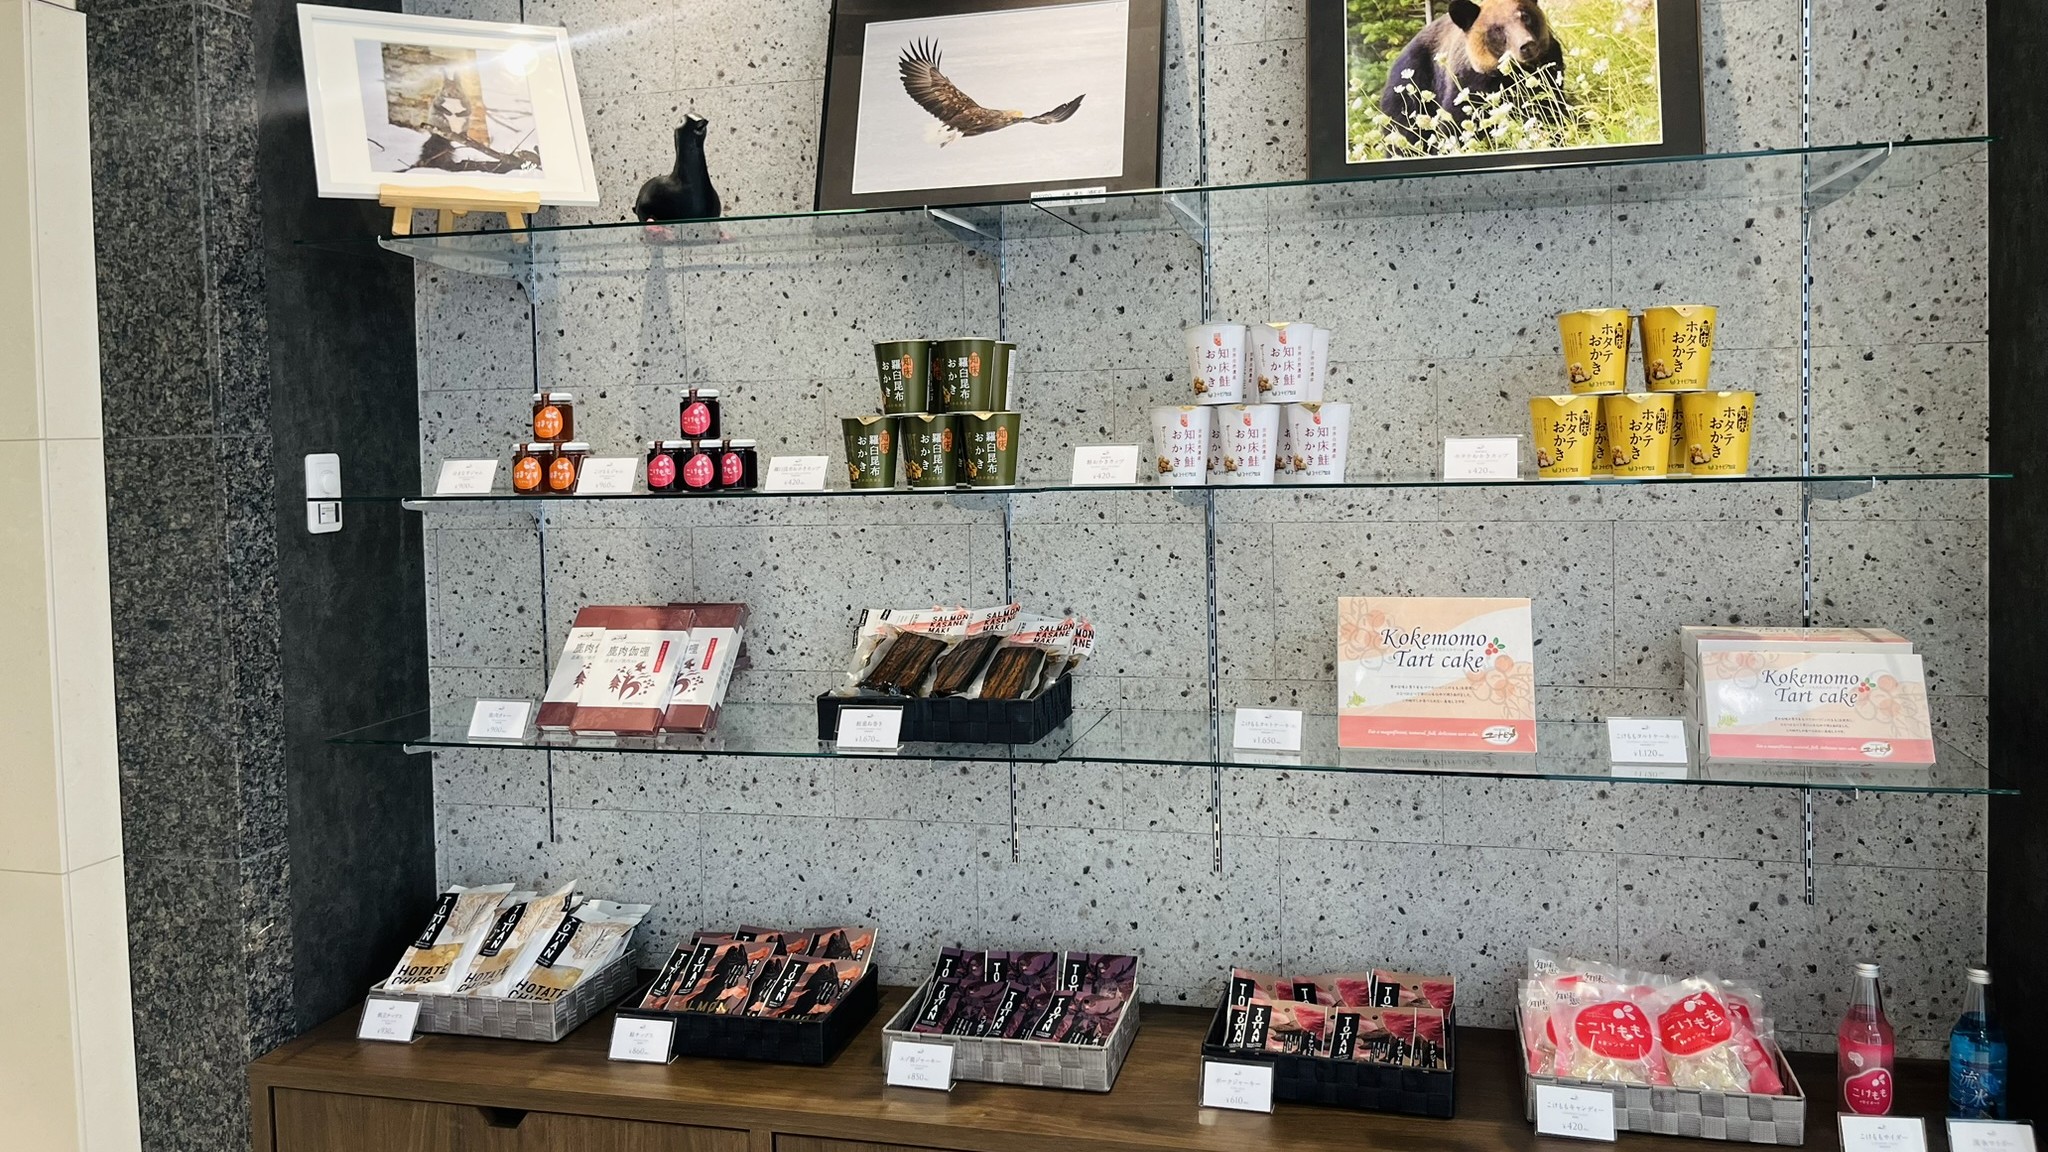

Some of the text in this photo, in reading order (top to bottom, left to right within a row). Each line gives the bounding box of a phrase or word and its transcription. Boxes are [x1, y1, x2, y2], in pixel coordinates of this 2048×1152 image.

[1589, 335, 1603, 376] おかき
[1601, 323, 1614, 363] ホタテ
[1672, 331, 1686, 373] おかき
[1686, 321, 1699, 361] ホタテ
[881, 361, 892, 398] おかき
[890, 359, 905, 401] 羅臼昆布
[948, 358, 957, 396] おかき
[959, 356, 970, 400] 羅臼昆布
[1206, 349, 1217, 388] おかき
[1219, 347, 1230, 388] 知床鮭
[1270, 347, 1282, 388] おかき
[1283, 346, 1295, 387] 知床鮭
[1317, 426, 1329, 466] 知床鮭
[1553, 421, 1567, 462] おかき
[1566, 411, 1578, 450] ホタテ
[1595, 421, 1607, 459] おかき
[1629, 419, 1643, 460] おかき
[1642, 409, 1655, 448] ホタテ
[1673, 409, 1683, 447] ホタテ
[1710, 417, 1724, 459] おかき
[1724, 407, 1735, 447] ホタテ
[858, 435, 868, 473] おかき
[869, 435, 881, 478] 羅臼昆布
[920, 434, 931, 472] おかき
[932, 432, 944, 476] 羅臼昆布
[975, 433, 985, 471] おかき
[986, 431, 998, 475] 羅臼昆布
[1172, 430, 1183, 468] おかき
[1184, 429, 1196, 468] 知床鮭
[1236, 429, 1247, 467] おかき
[1248, 428, 1260, 467] 知床鮭
[1305, 428, 1315, 466] おかき
[784, 478, 801, 486] ¥420
[1093, 472, 1111, 480] ¥420
[1468, 467, 1489, 475] ¥420
[929, 620, 964, 629] KASANE
[932, 614, 969, 623] SALMON
[982, 624, 1004, 632] MAKI
[984, 614, 1017, 626] KASANE
[986, 606, 1021, 620] SALMON
[1039, 623, 1075, 633] SALMON
[1033, 637, 1055, 645] MAKI
[1035, 631, 1070, 639] KASANE
[1072, 639, 1092, 650] ANE
[1075, 629, 1095, 641] MON
[1381, 626, 1487, 650] Kokemomo
[1393, 649, 1484, 673] Tart cake
[1762, 667, 1859, 687] Kokemomo
[1774, 687, 1858, 708] Tart cake
[422, 896, 452, 942] TOTTAN
[490, 905, 522, 950] TOTTAN
[391, 975, 434, 986] CHIPS
[685, 947, 711, 988] TOTTAN
[775, 963, 801, 1002] TOTTAN
[927, 984, 949, 1021] TOTTAN
[993, 991, 1017, 1030] TOTTAN
[1042, 997, 1065, 1033] TOTTAN
[1251, 1007, 1265, 1043] TOTTAN
[1338, 1016, 1352, 1056] TOTTAN
[1587, 1022, 1645, 1041] こけもも
[1667, 1009, 1722, 1041] こけもも
[1547, 1101, 1605, 1113] こけももキャンディー
[1852, 1087, 1888, 1101] こけもも
[1562, 1122, 1584, 1132] ¥420
